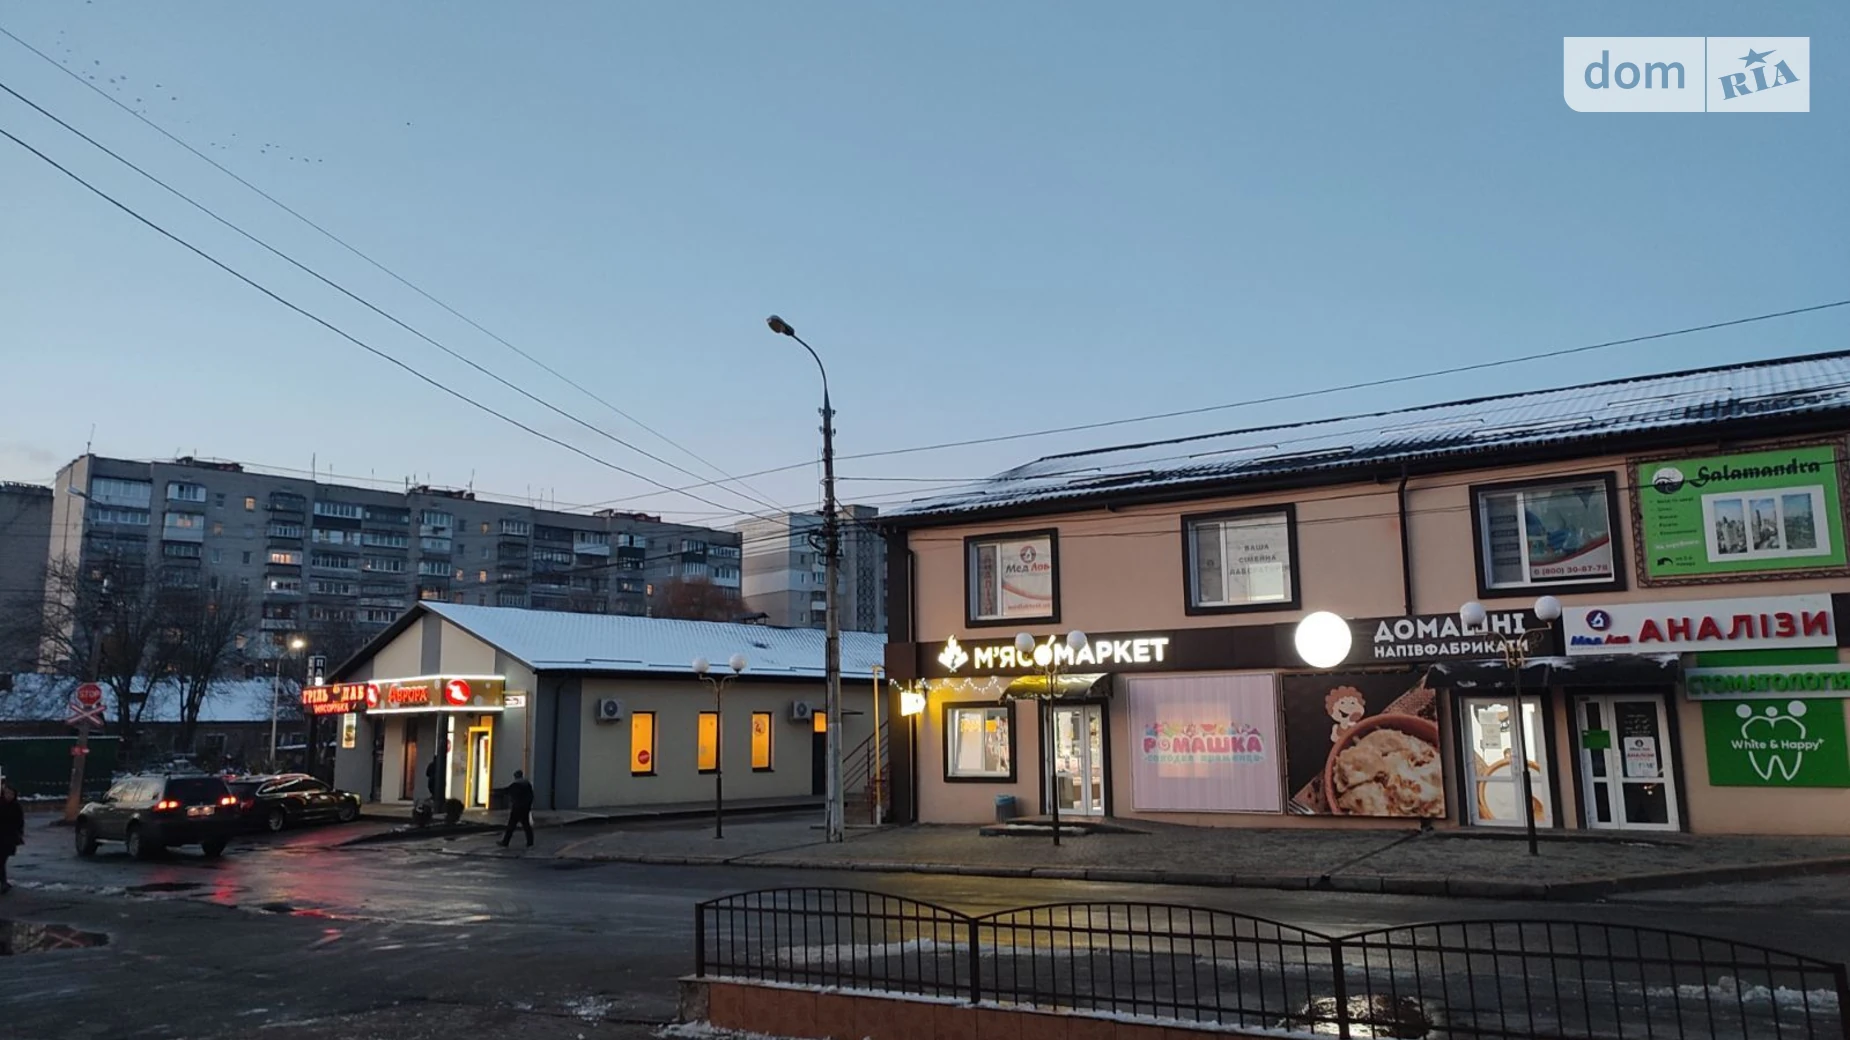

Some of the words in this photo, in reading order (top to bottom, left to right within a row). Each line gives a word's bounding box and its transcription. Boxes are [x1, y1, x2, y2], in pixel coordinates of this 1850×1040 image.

[1688, 457, 1821, 487] Salamandra
[1244, 543, 1269, 551] ВАША
[1374, 612, 1526, 644] ДОМАШНІ
[1638, 610, 1830, 644] АНАЛІЗИ
[1374, 639, 1530, 659] НАПІВФАБРИКАТИ
[1143, 736, 1263, 754] РОМАШКА
[1730, 739, 1767, 750] White
[1769, 739, 1779, 750] &
